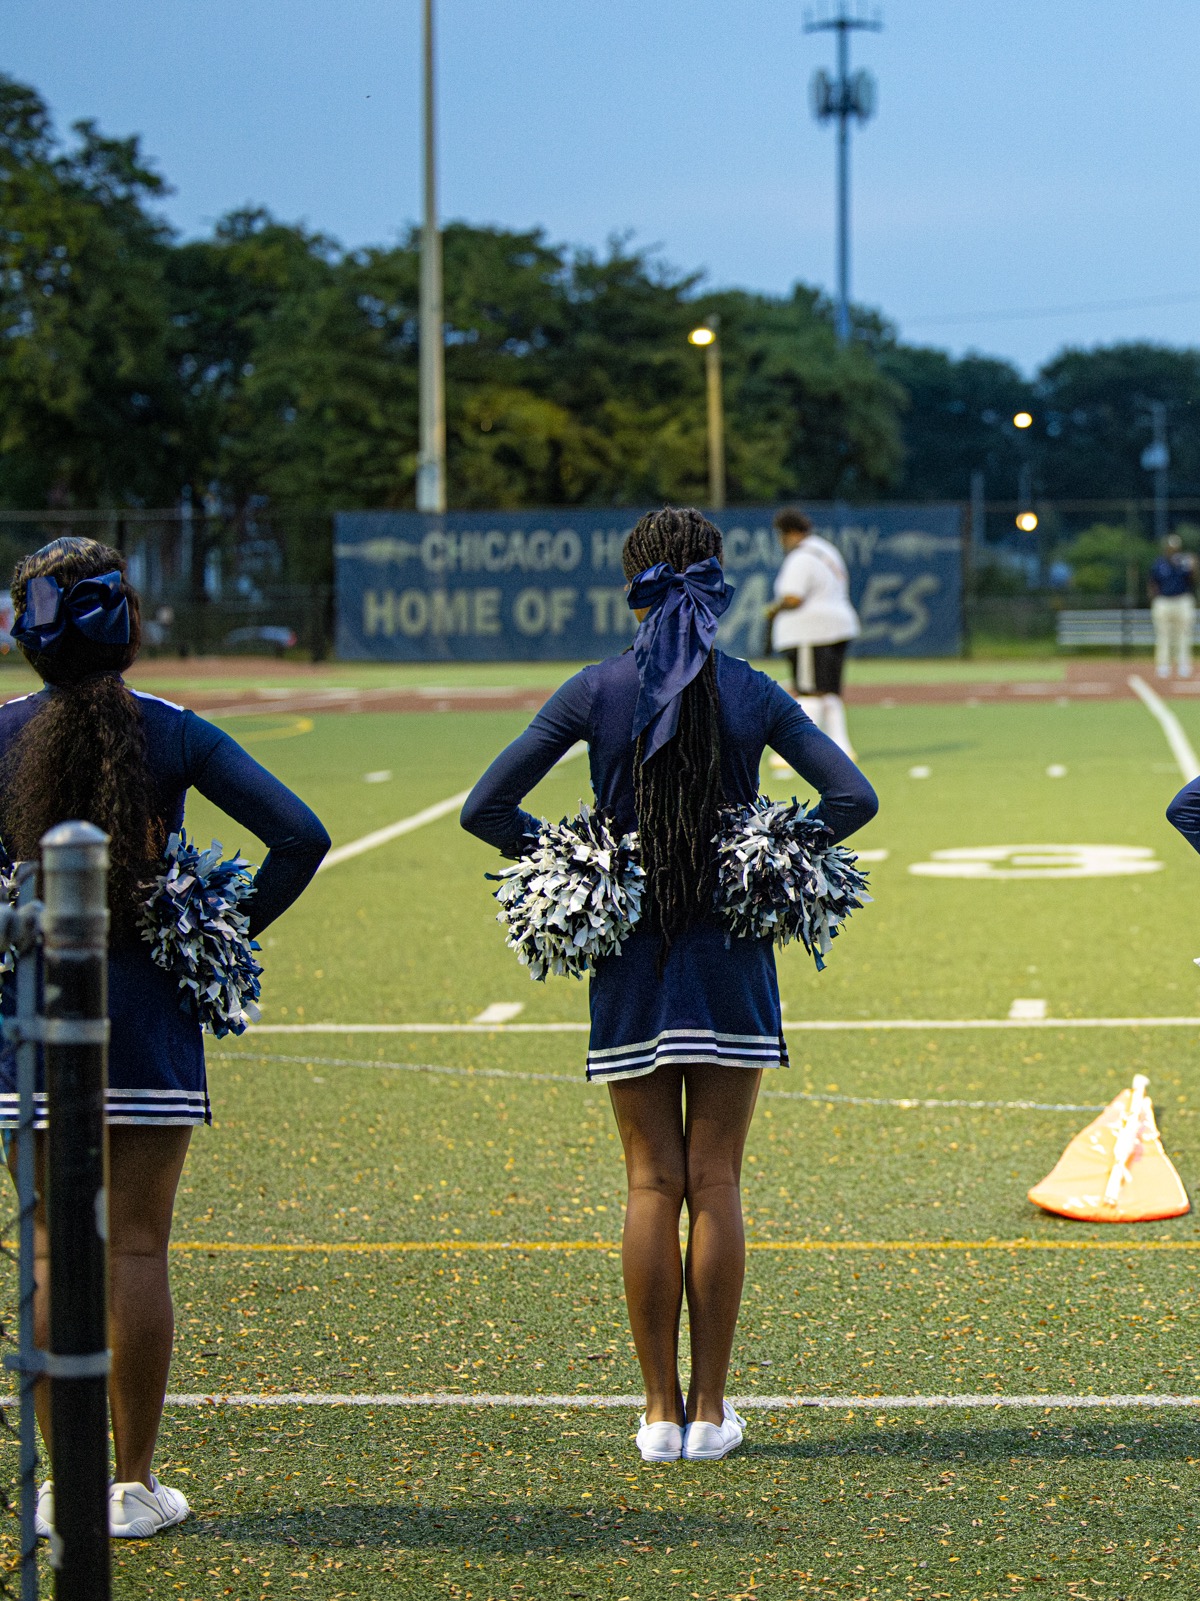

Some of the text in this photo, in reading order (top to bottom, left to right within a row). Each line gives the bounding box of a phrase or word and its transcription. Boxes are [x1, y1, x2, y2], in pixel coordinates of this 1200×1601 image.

[421, 530, 583, 573] CHICAGO
[362, 587, 501, 637] HOME
[512, 587, 577, 636] OF
[588, 587, 639, 636] TH
[908, 843, 1166, 880] 3
